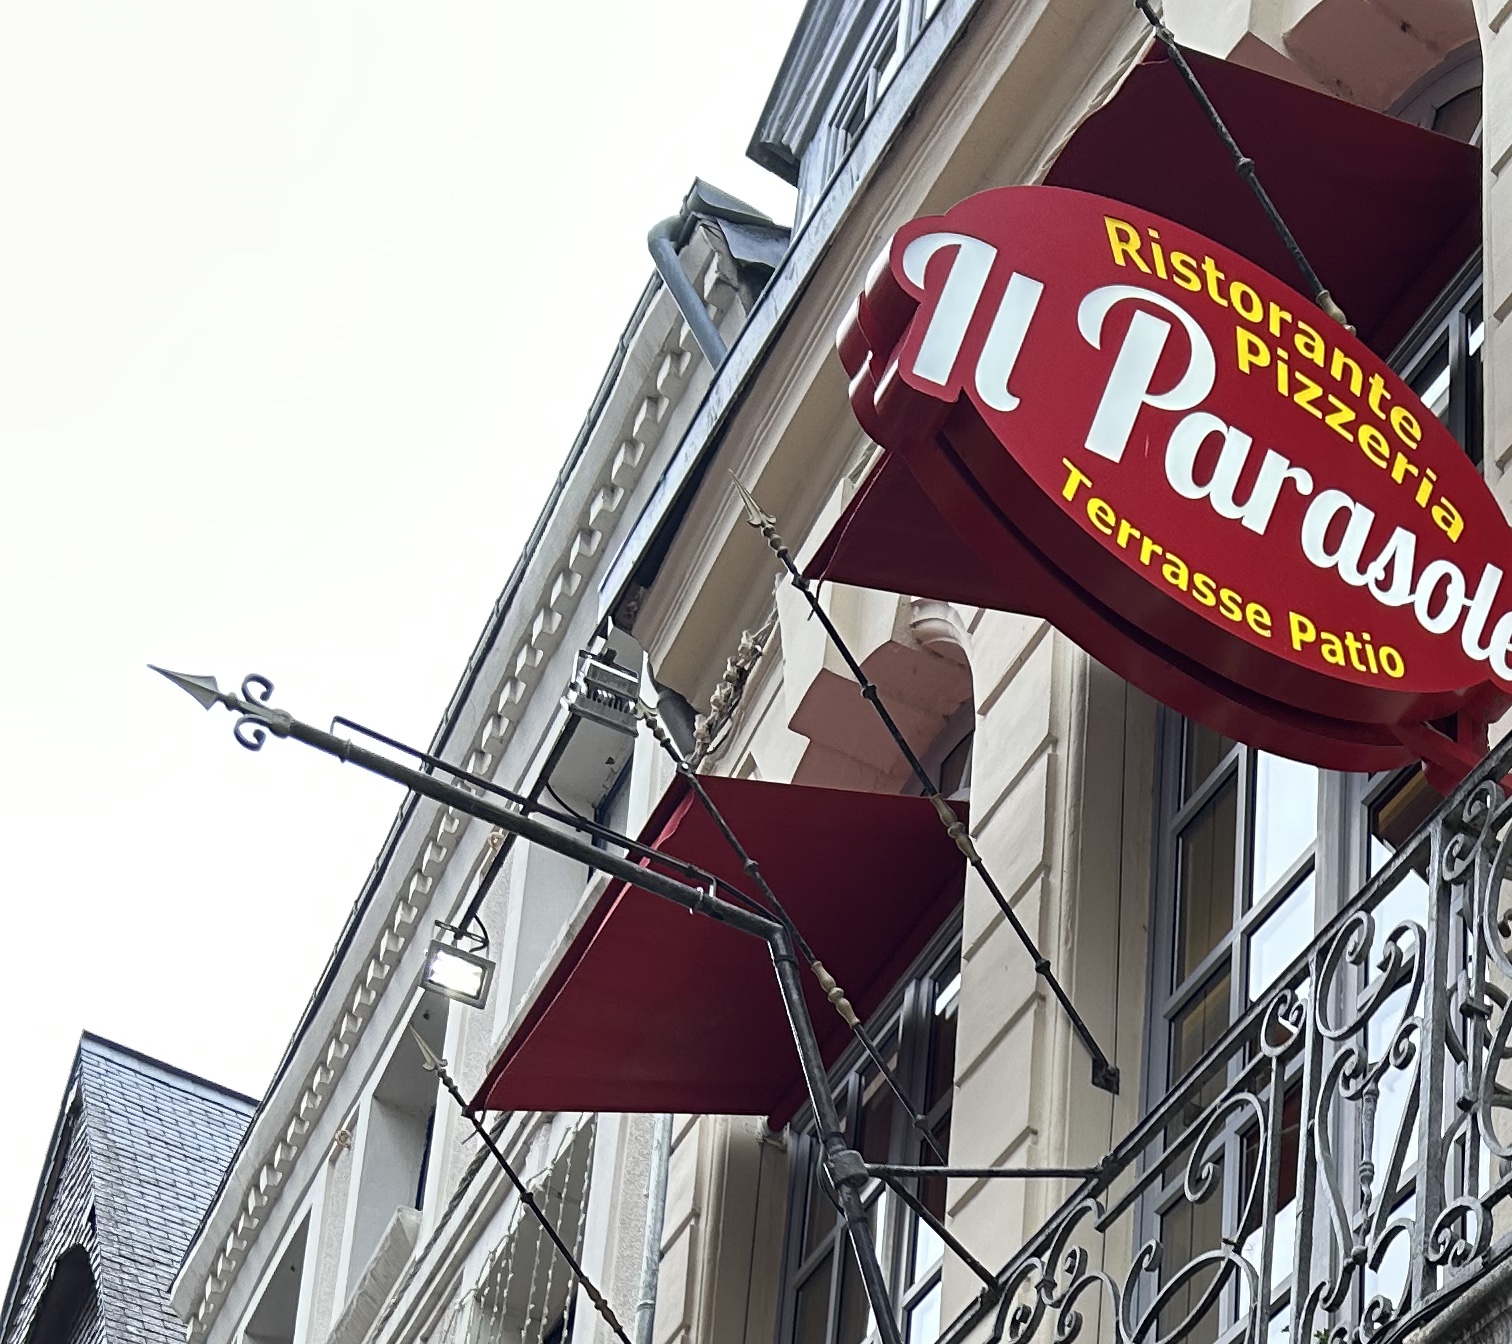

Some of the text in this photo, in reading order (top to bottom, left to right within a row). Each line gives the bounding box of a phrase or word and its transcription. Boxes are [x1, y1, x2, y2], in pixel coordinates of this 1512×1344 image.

[901, 231, 1045, 414] Il
[1103, 214, 1424, 450] Ristorante
[1236, 325, 1465, 544] Pizzeria
[1062, 458, 1406, 679] Terrasse Patio
